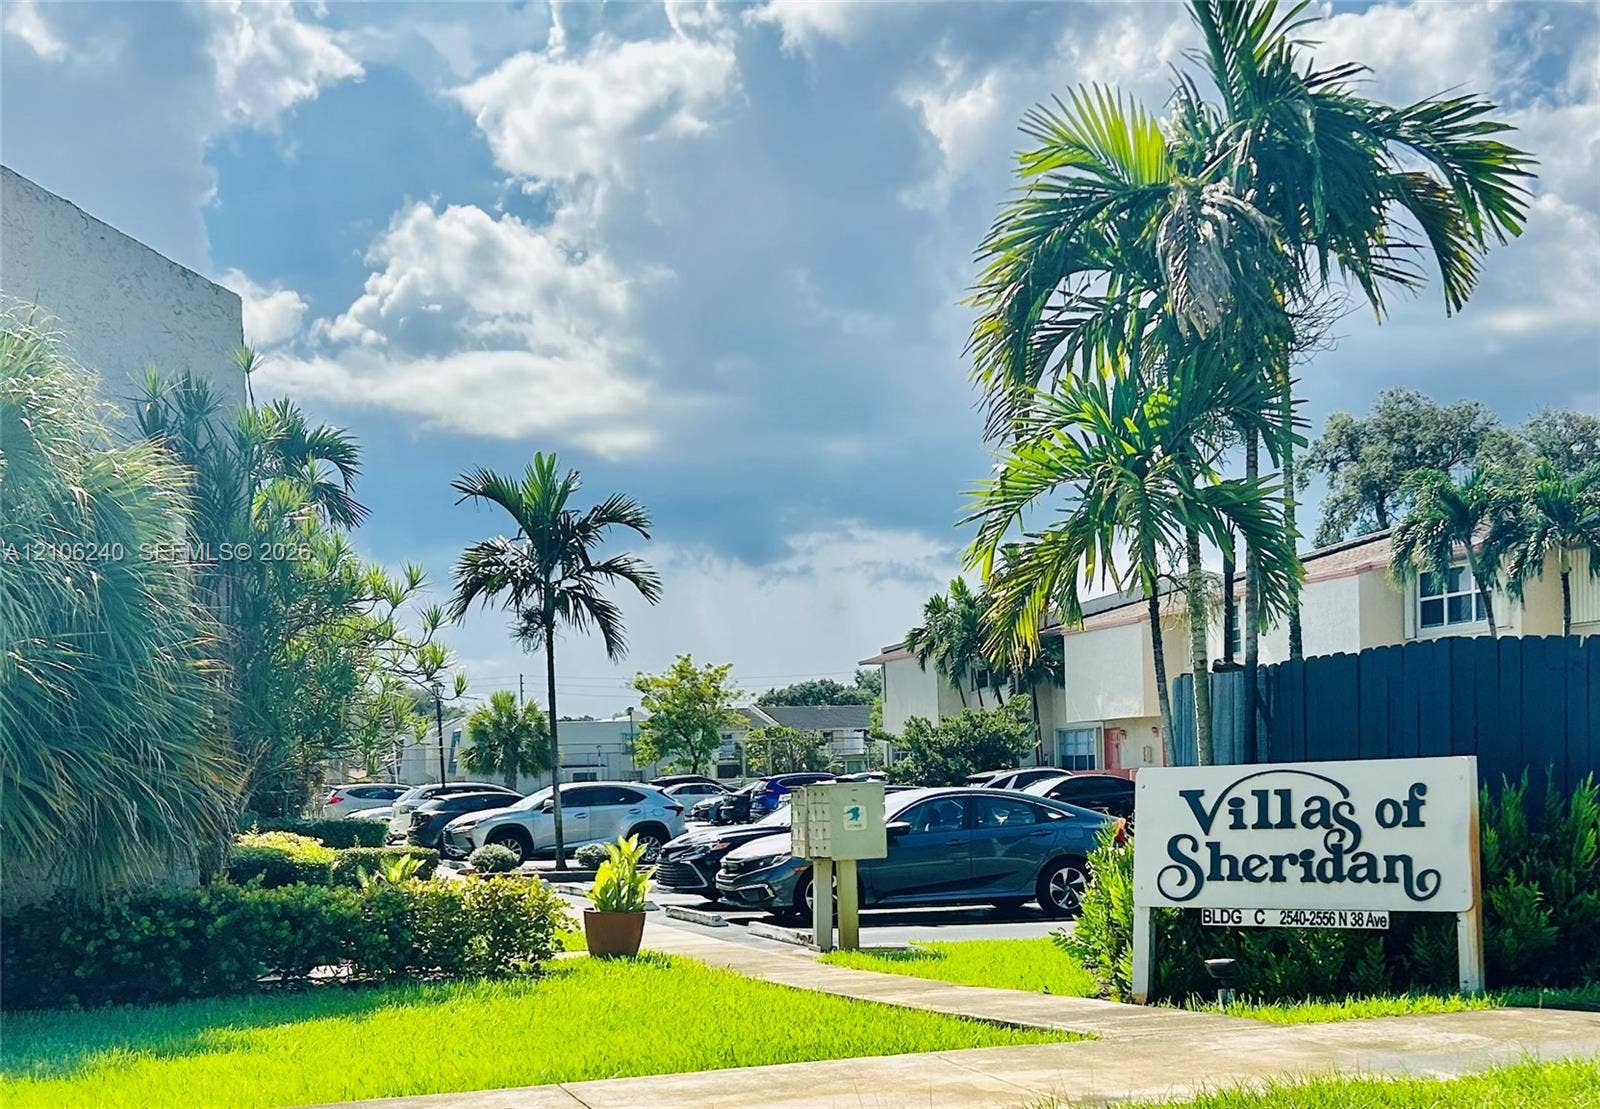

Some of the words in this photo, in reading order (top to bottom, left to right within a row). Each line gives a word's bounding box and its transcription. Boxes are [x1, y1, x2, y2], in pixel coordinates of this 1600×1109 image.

[1179, 769, 1362, 855] Villas
[1375, 782, 1427, 829] of
[1157, 833, 1441, 902] Sheridan
[1202, 909, 1242, 925] BLDG
[1254, 909, 1265, 925] C
[1279, 910, 1335, 926] 2540-2556
[1338, 911, 1347, 927] N
[1350, 911, 1364, 927] 38
[1366, 912, 1388, 928] Ave
